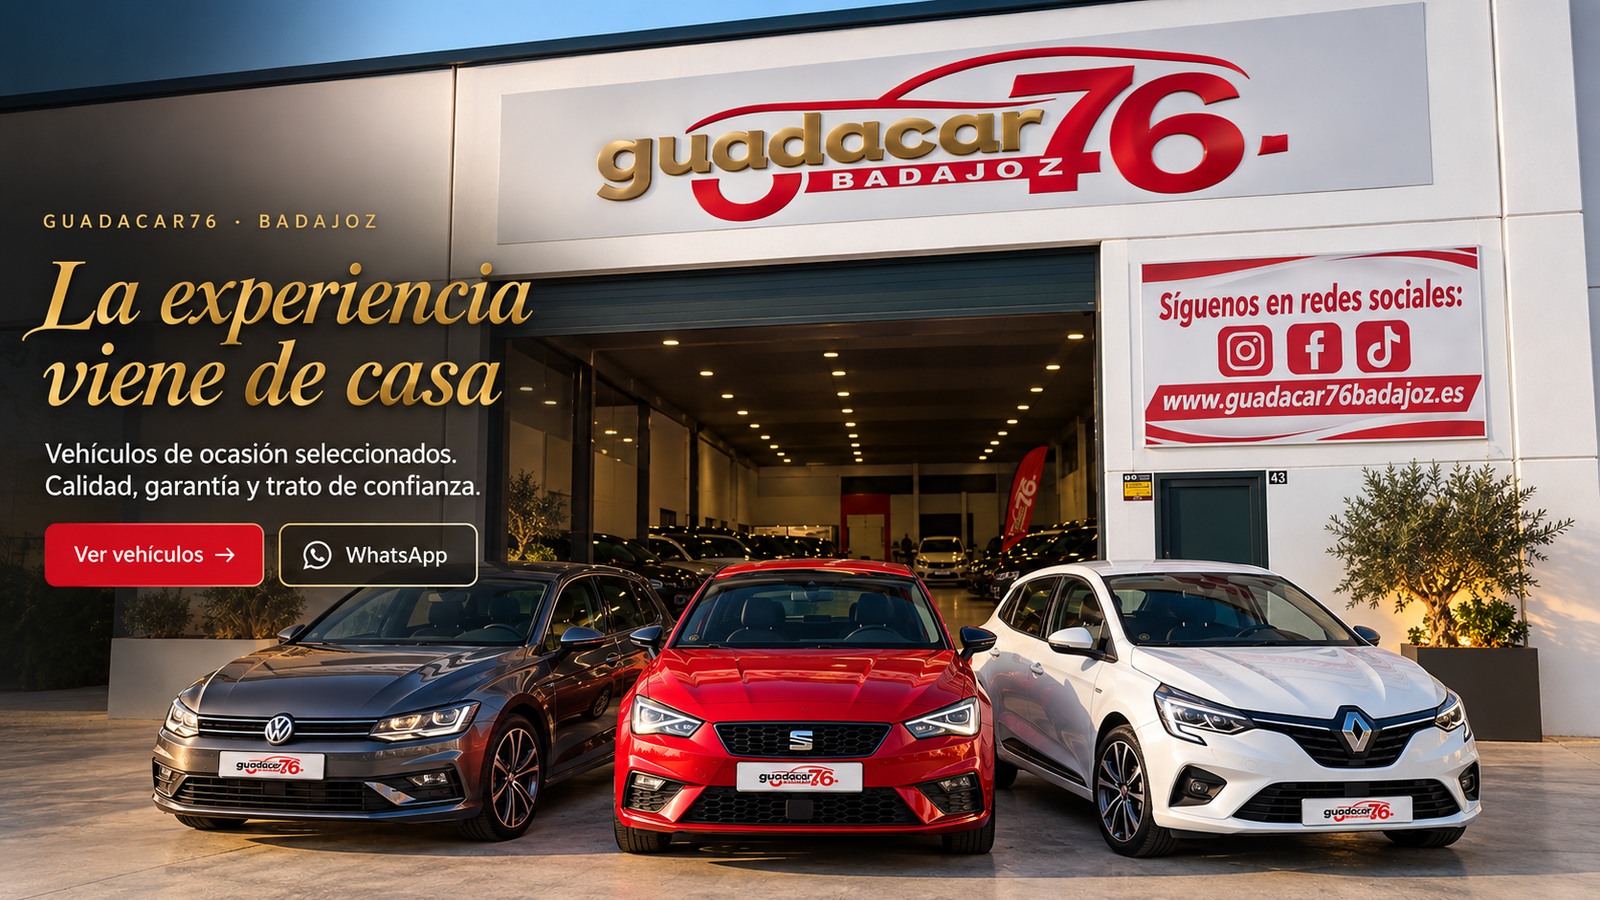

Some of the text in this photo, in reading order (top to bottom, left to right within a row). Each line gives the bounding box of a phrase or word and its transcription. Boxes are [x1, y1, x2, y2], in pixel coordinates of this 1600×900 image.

[832, 157, 1063, 189] BADAJOZ
[1159, 278, 1463, 328] Síguenos en redes sociales:
[1163, 383, 1465, 415] www.guadacar76badajoz.es
[1271, 472, 1285, 483] 43
